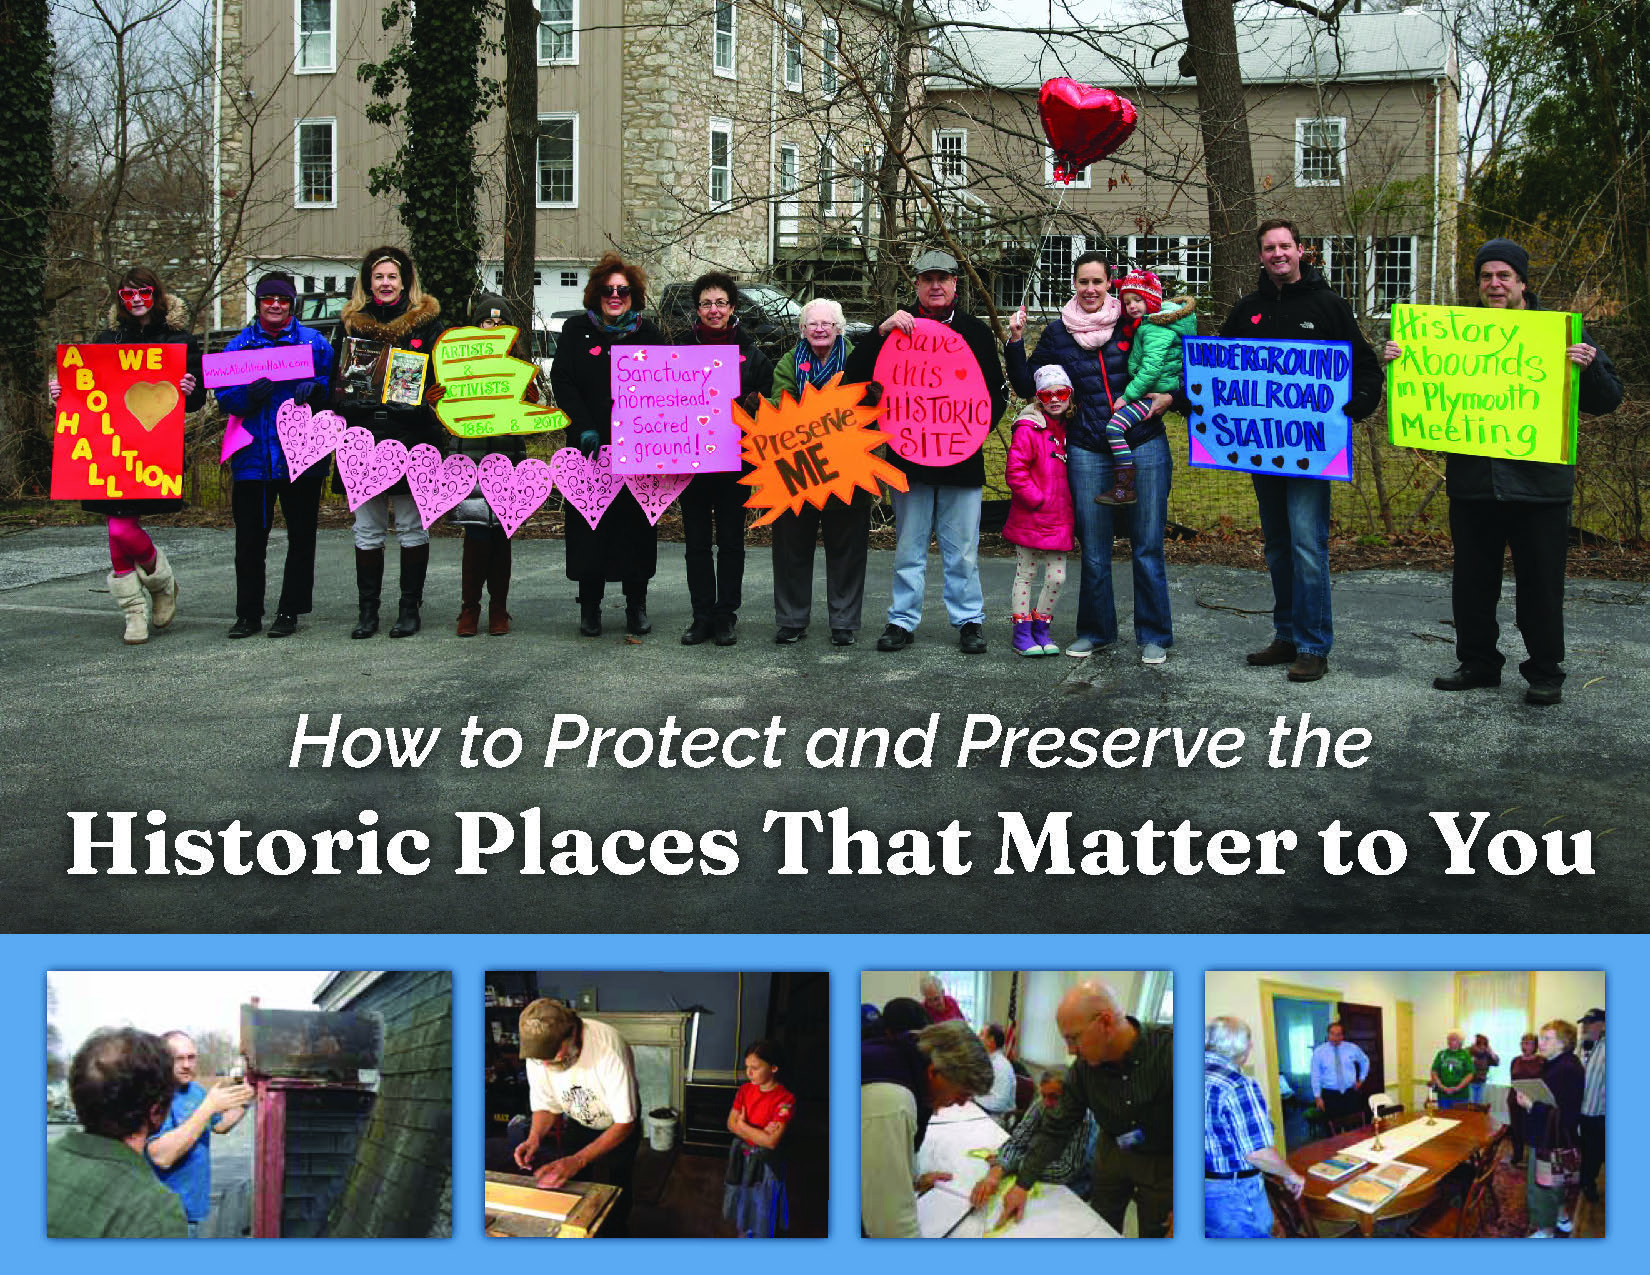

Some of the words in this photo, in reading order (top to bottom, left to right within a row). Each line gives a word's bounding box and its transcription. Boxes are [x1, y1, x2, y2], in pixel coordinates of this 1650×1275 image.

[441, 342, 494, 359] ARTISTS
[1396, 308, 1520, 357] History
[118, 347, 163, 371] WE
[616, 355, 713, 387] Sanctuary
[892, 360, 942, 388] this
[1186, 342, 1350, 382] UNDERGROUND
[1401, 341, 1547, 383] Abounds
[618, 385, 710, 408] homestead.
[1211, 376, 1335, 413] RAILROAD
[1422, 382, 1540, 426] Plymouth
[633, 415, 688, 434] Sacred
[1211, 413, 1327, 452] STATION
[1401, 413, 1537, 456] Meeting
[56, 411, 123, 498] HALL
[634, 433, 700, 463] ground!
[773, 442, 840, 497] ME
